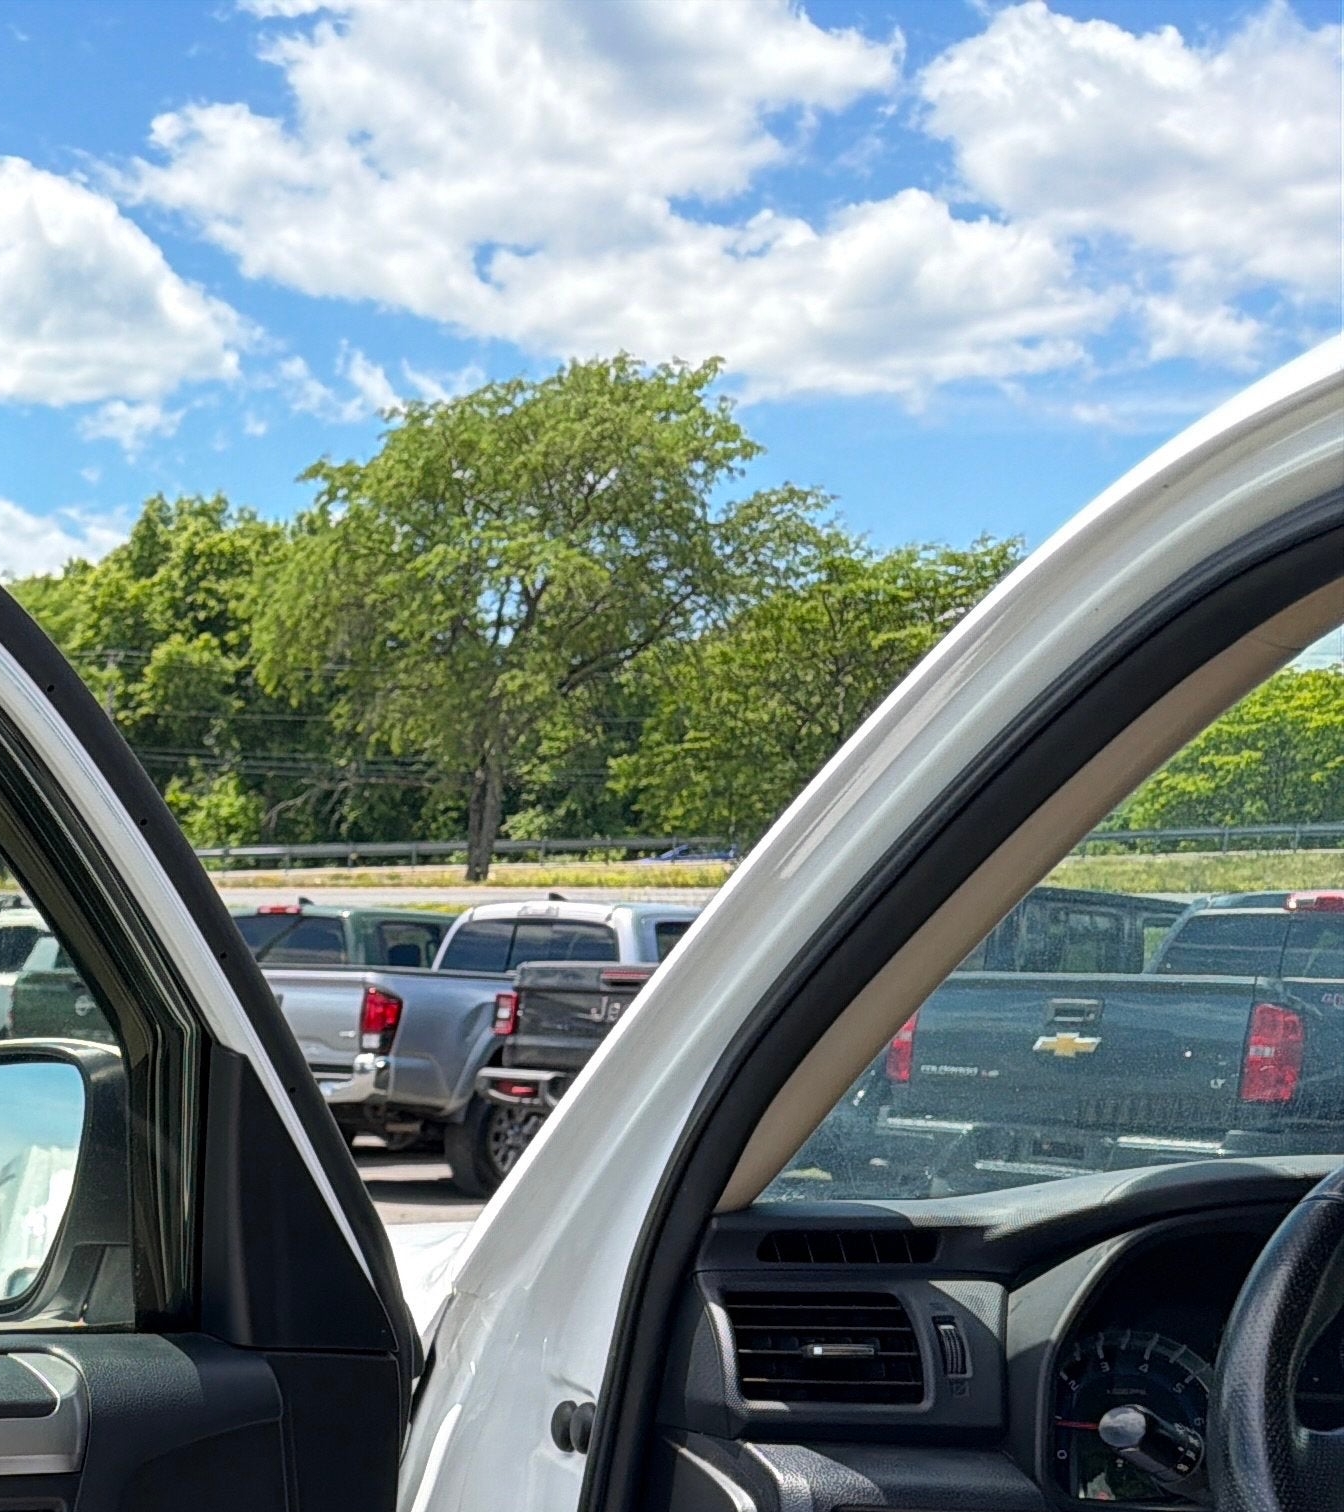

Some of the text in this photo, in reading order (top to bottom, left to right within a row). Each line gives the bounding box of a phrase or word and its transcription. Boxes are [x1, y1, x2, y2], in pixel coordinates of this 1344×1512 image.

[1100, 1362, 1110, 1373] 3
[1138, 1363, 1149, 1374] 4
[1068, 1380, 1080, 1392] 2
[1173, 1382, 1185, 1394] 5
